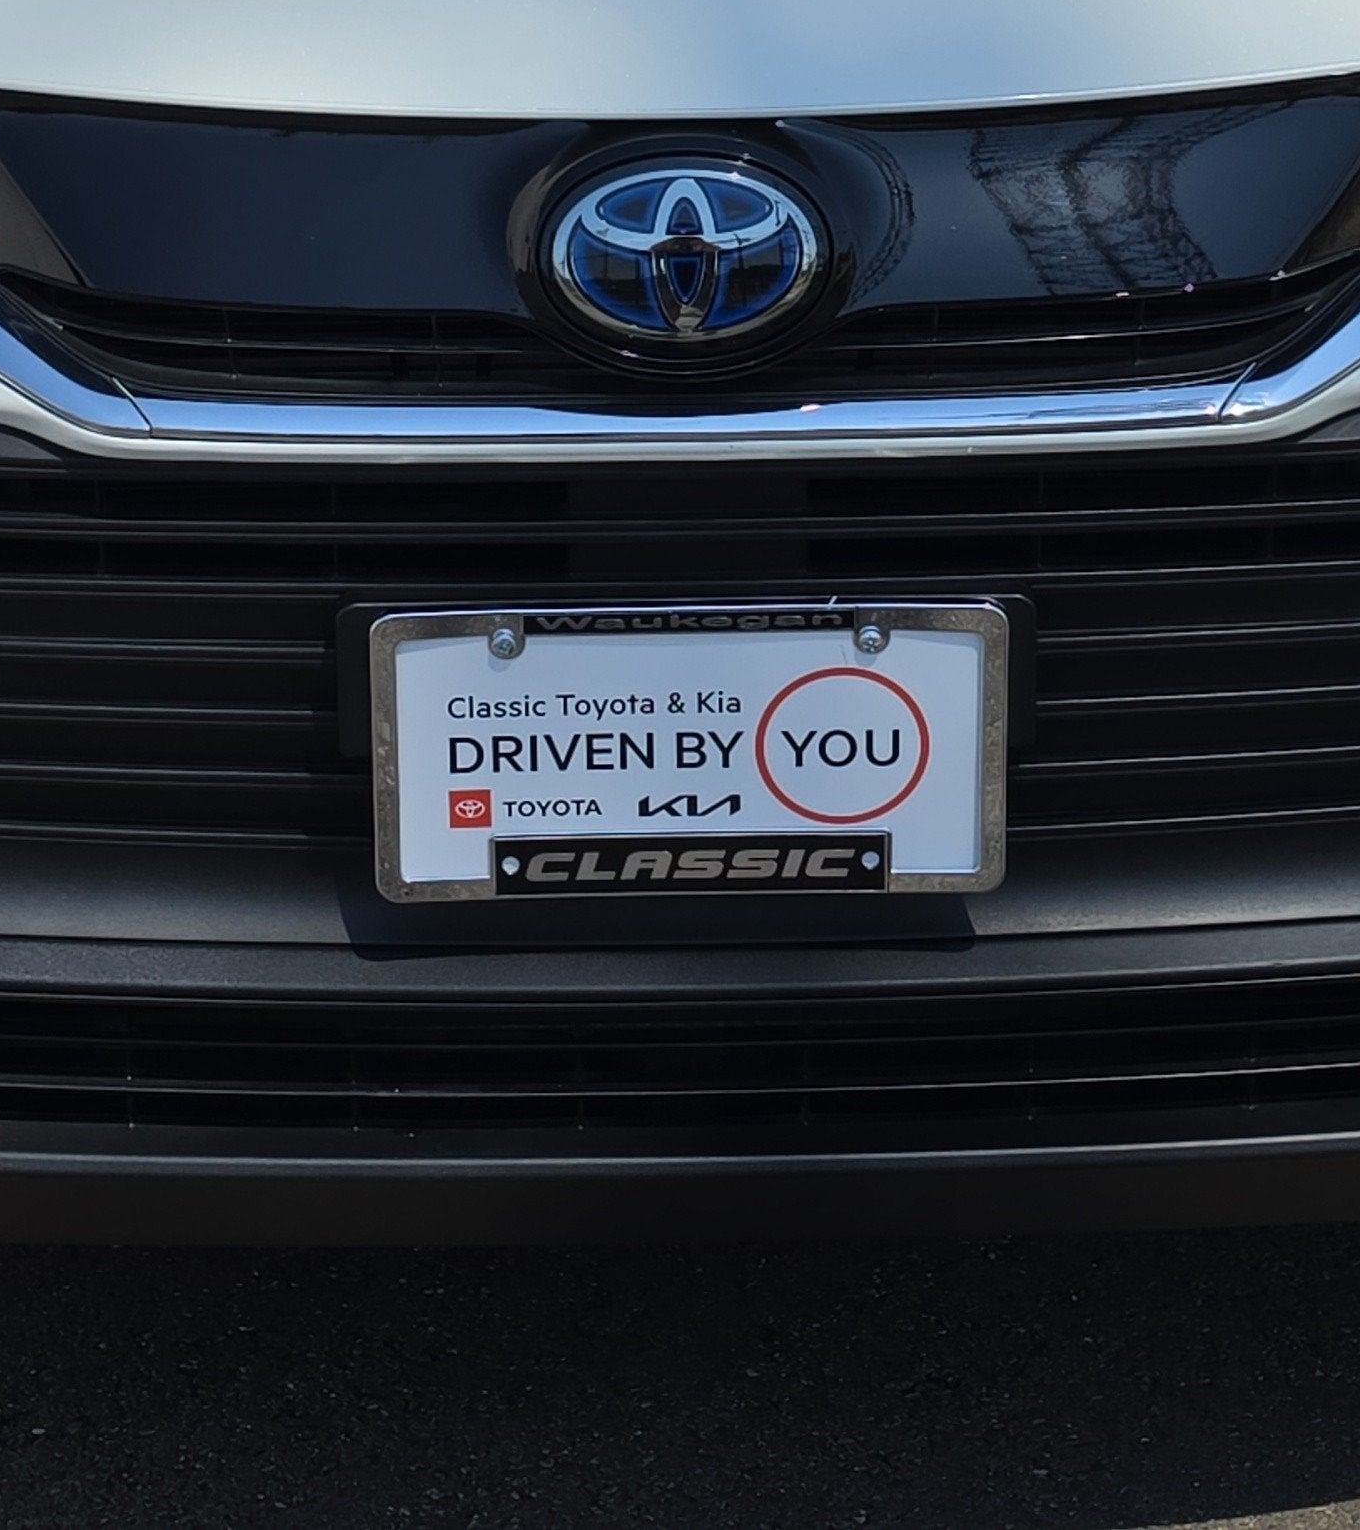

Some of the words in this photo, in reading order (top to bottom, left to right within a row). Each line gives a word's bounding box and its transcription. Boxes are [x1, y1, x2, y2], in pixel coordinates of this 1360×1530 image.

[536, 612, 843, 631] Waukegan
[447, 694, 546, 719] Classic
[555, 693, 655, 721] Toyota
[667, 693, 687, 715] &
[696, 690, 741, 715] Kia
[449, 732, 655, 774] DRIVEN
[676, 730, 744, 769] BY
[781, 728, 902, 767] YOU
[503, 797, 602, 818] TOYOTA
[524, 847, 856, 884] CLASSIC
